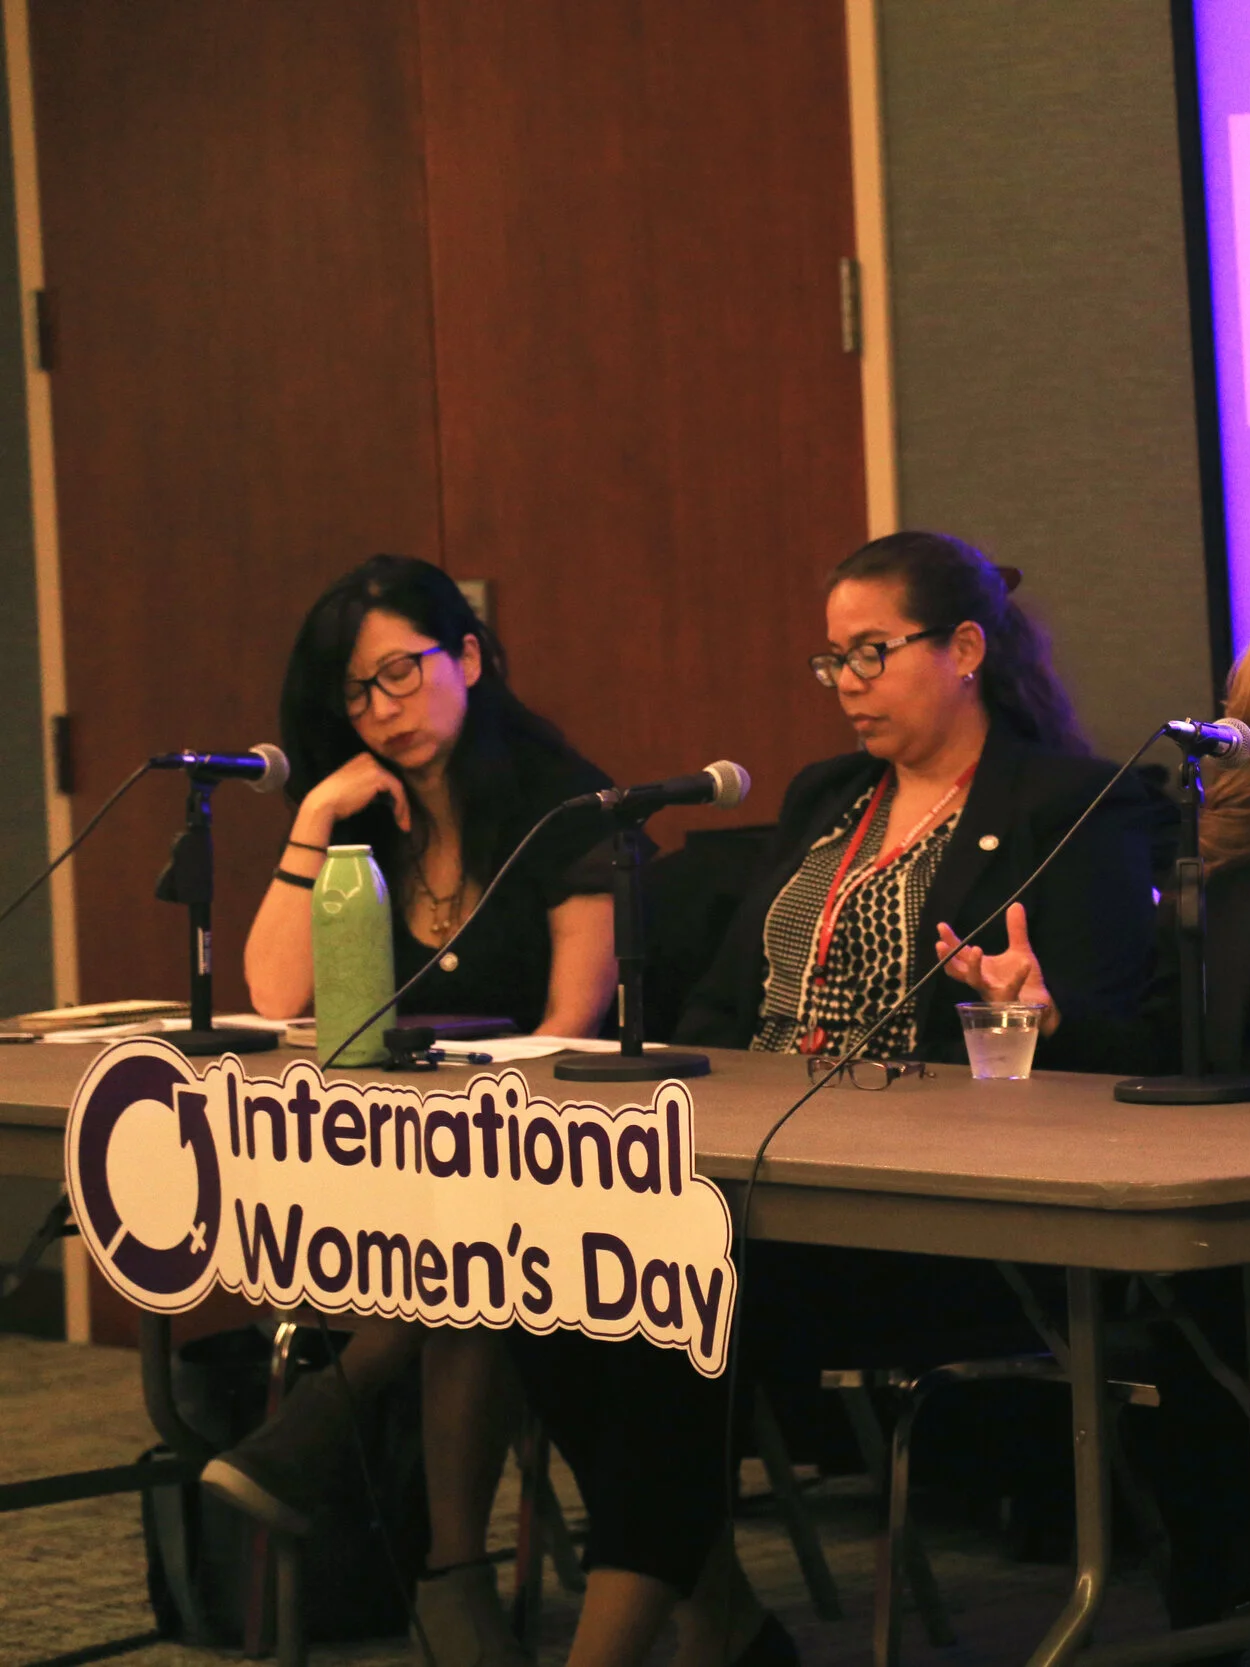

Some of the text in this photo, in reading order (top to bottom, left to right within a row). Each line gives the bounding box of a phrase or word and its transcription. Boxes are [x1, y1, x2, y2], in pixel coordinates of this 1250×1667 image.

[226, 1071, 683, 1197] International
[234, 1197, 723, 1359] Women's Day
